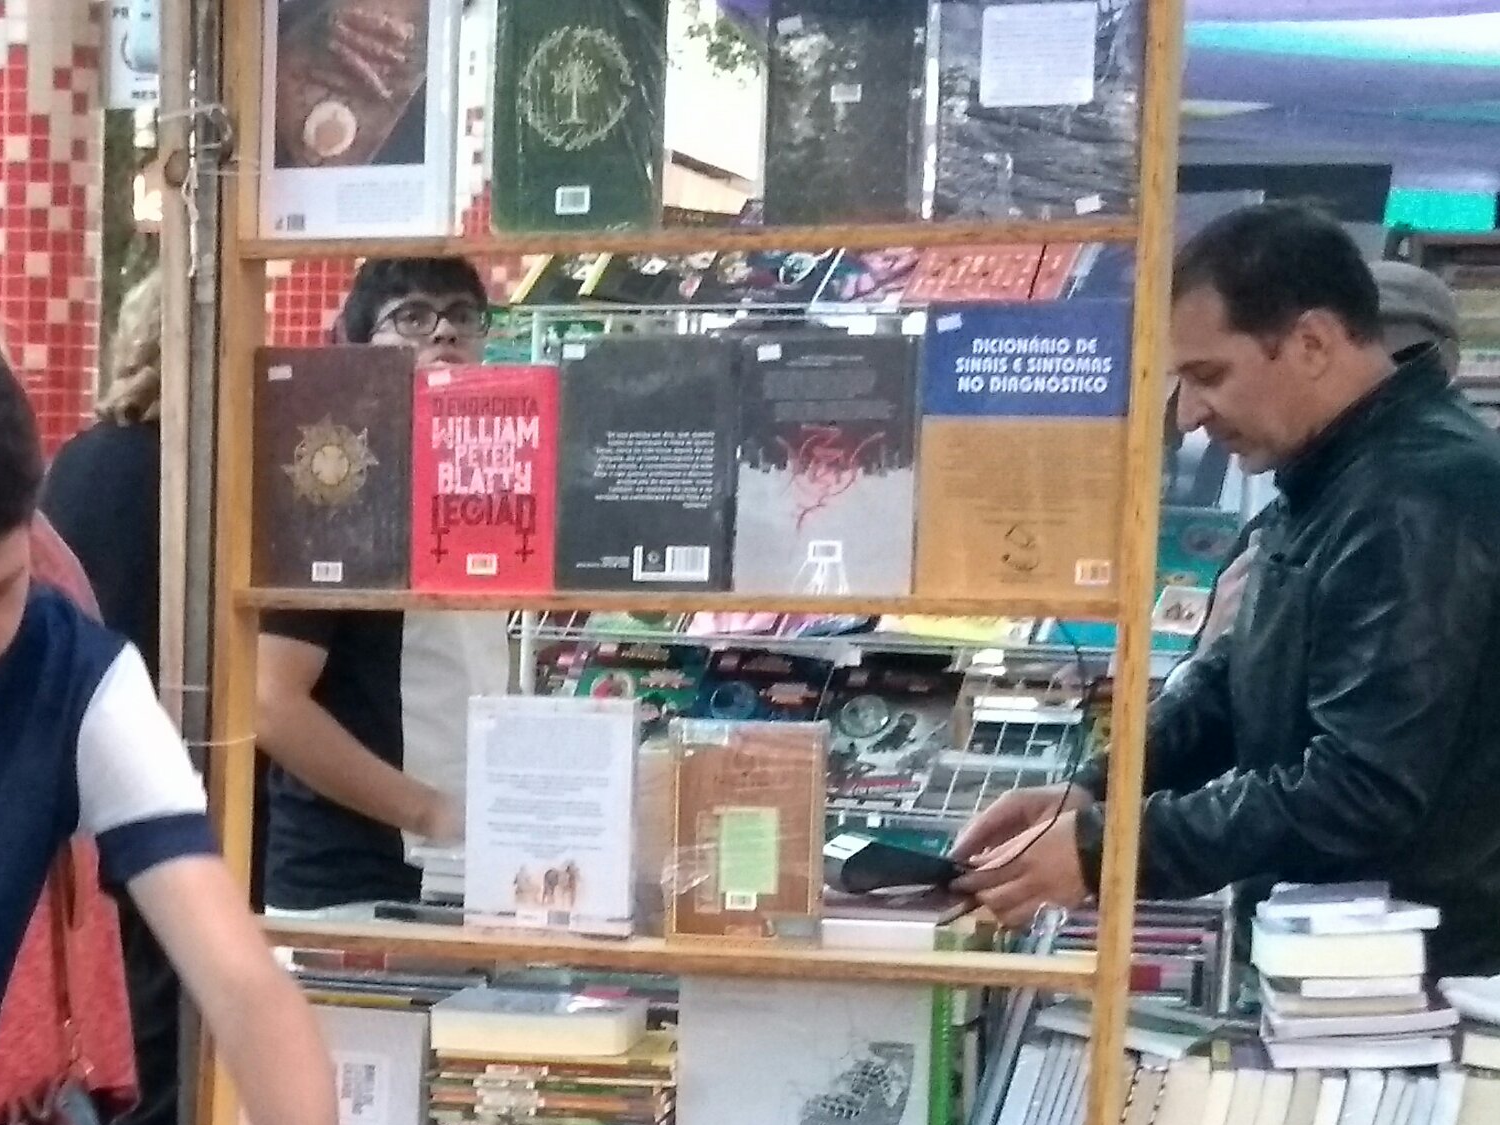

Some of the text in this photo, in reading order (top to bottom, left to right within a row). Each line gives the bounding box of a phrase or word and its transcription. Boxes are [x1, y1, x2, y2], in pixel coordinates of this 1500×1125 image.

[972, 335, 1097, 354] DICIONÁRIO DE
[955, 357, 1113, 373] SINAIS E SINTOMAS
[957, 373, 1109, 394] NO DIAGNÓSTICO
[431, 415, 540, 449] WILLIAM
[454, 444, 516, 468] PETER
[437, 461, 533, 494] BLATTY
